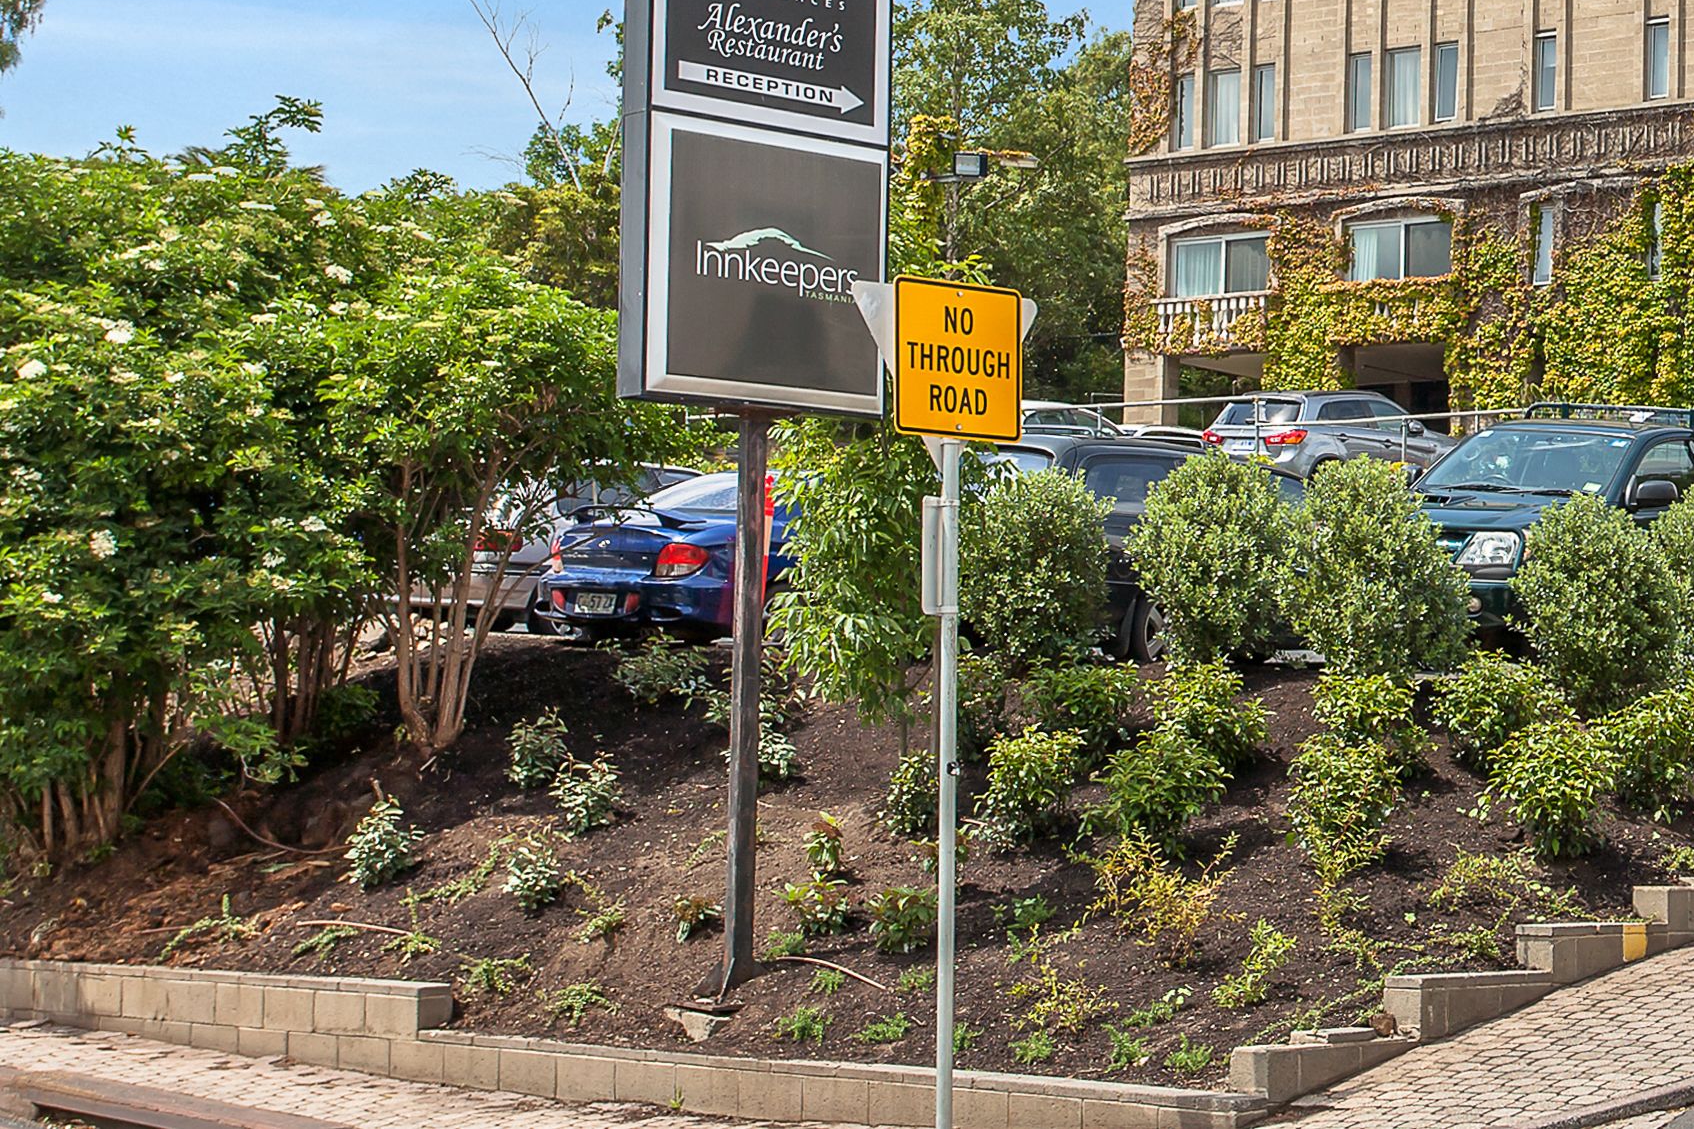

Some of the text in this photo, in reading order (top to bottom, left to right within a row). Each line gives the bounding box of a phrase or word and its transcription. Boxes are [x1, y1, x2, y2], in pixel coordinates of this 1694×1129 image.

[697, 2, 844, 53] Alexander's
[706, 29, 825, 71] Restaurant
[706, 68, 834, 104] RECEPTION
[695, 239, 859, 298] Innkeepers
[944, 304, 975, 336] NO
[906, 340, 1011, 380] THROUGH
[928, 383, 989, 416] ROAD
